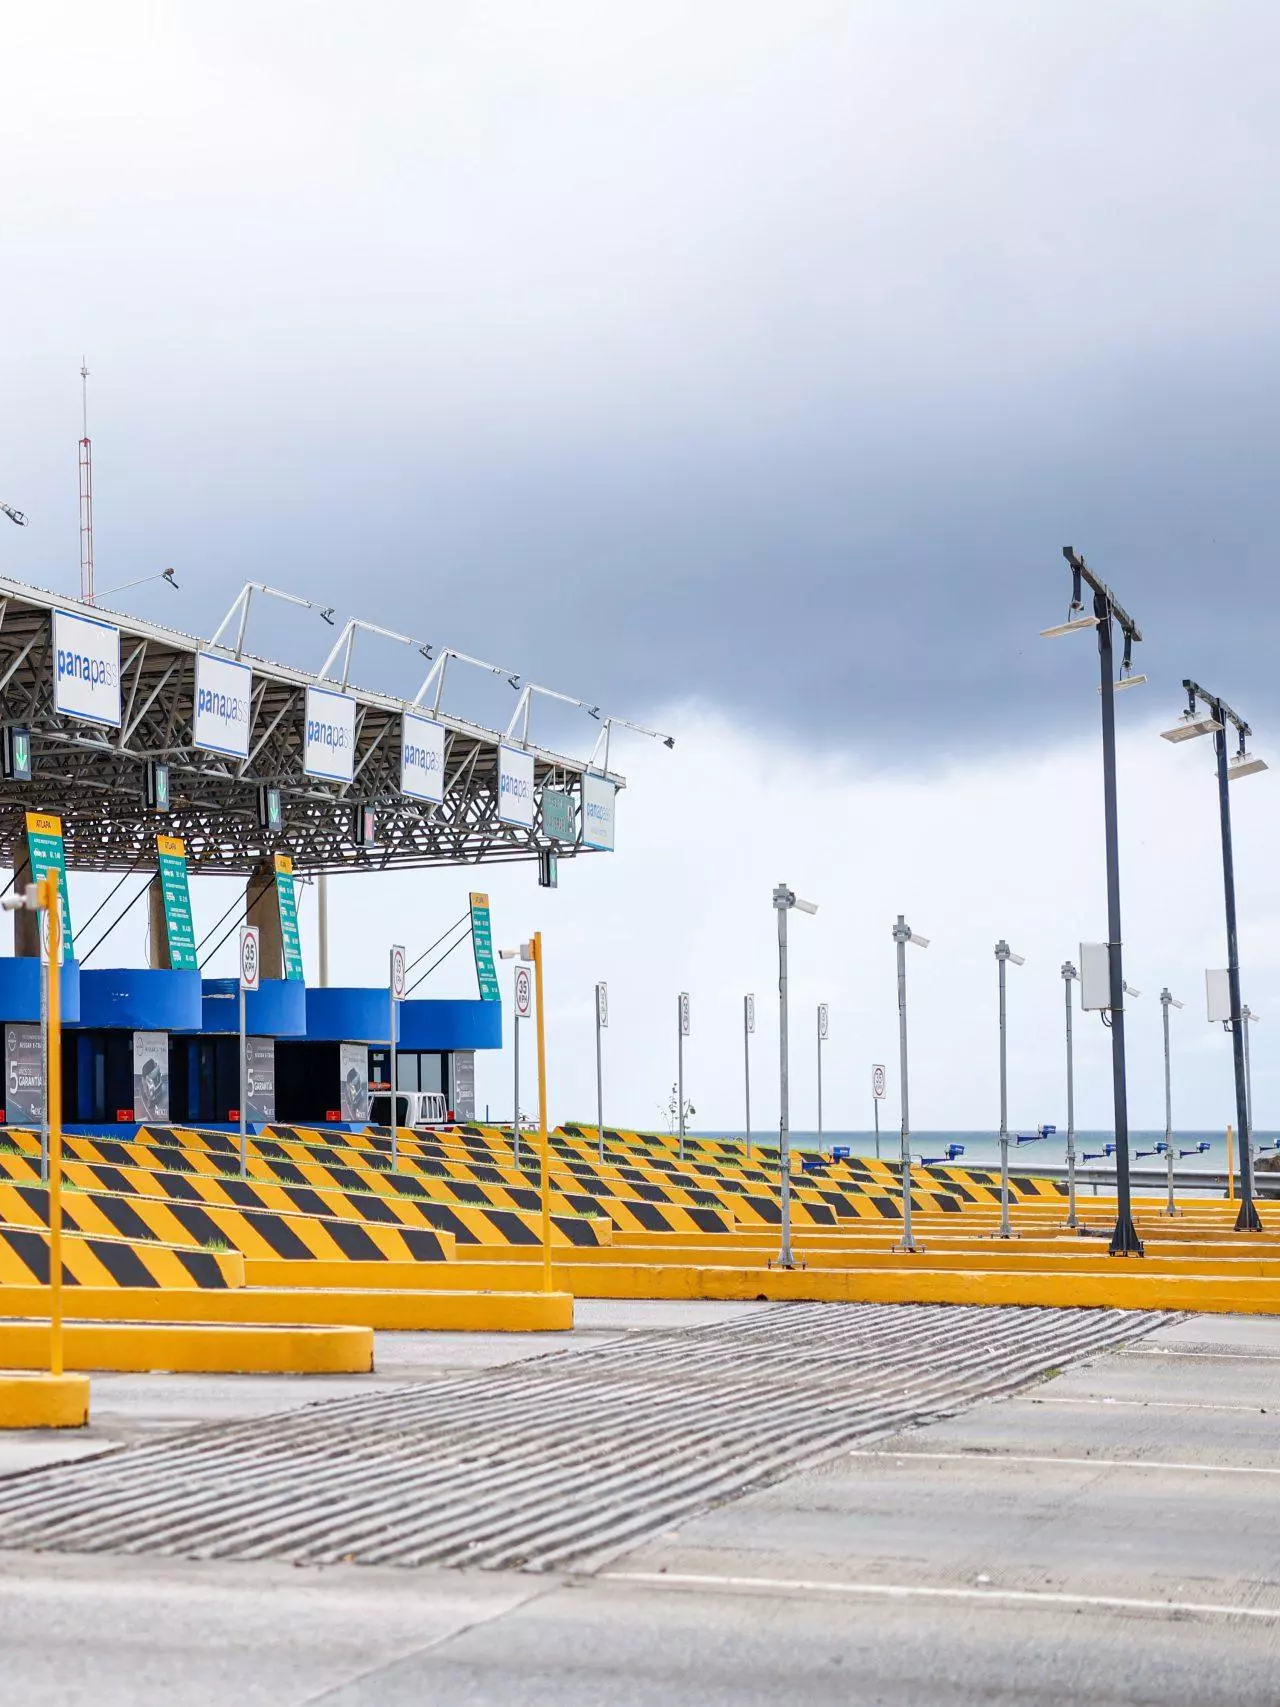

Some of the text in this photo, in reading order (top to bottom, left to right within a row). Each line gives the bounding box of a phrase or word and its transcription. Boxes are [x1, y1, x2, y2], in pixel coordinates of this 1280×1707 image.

[57, 649, 118, 691] panapass
[197, 688, 248, 726] panapass
[307, 719, 352, 754] panapass
[404, 744, 441, 775] panapass
[36, 819, 52, 829] ATLAPA
[244, 961, 255, 972] KPH
[245, 943, 255, 961] 35
[519, 980, 527, 994] 35
[9, 1060, 19, 1094] 5
[247, 1068, 255, 1098] 5
